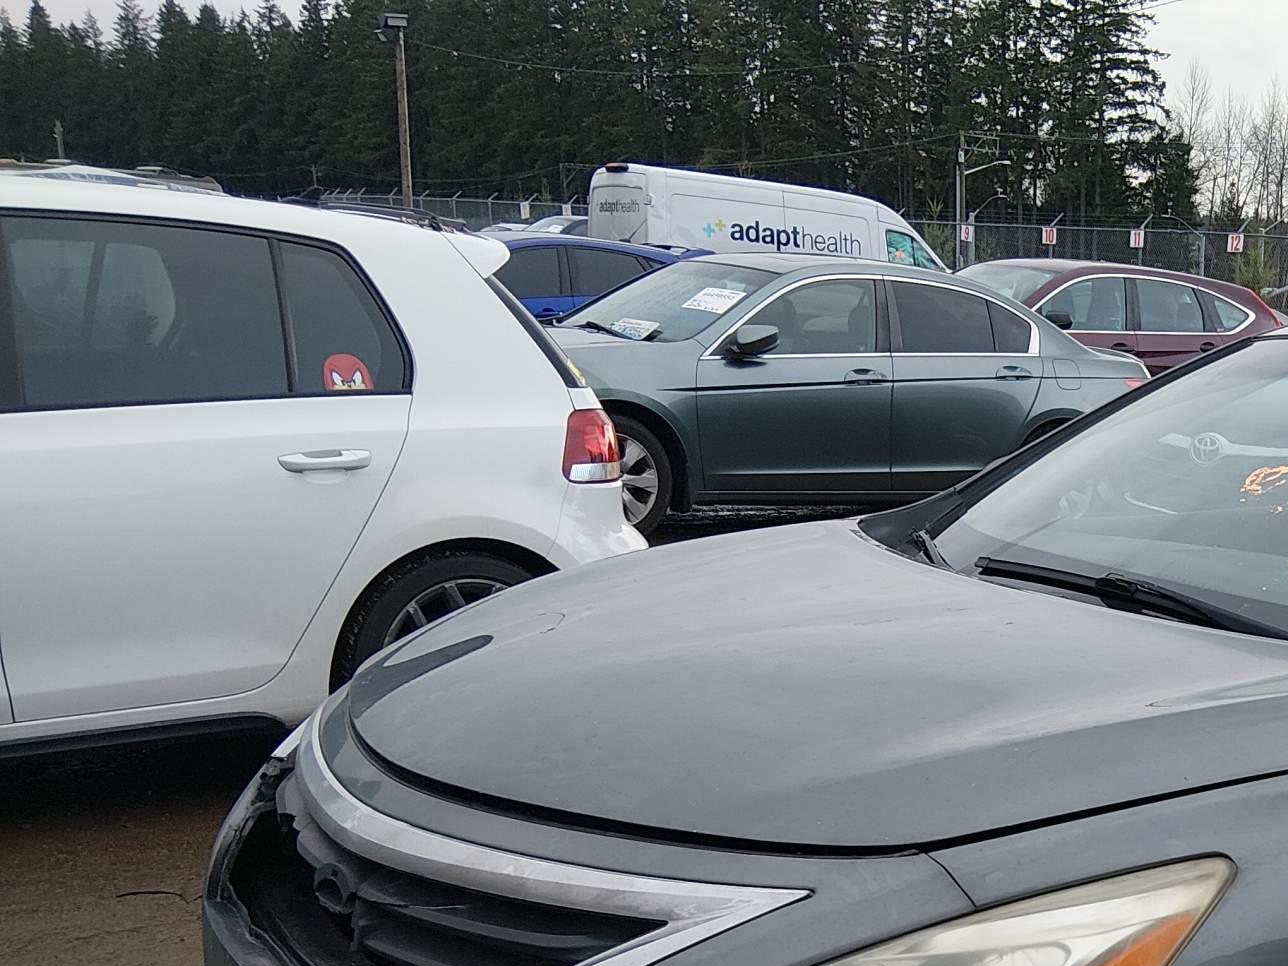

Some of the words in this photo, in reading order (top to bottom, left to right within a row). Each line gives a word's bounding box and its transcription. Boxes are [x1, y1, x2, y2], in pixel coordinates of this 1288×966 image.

[599, 200, 640, 215] adapthealth
[730, 221, 861, 255] adapthealth
[963, 227, 970, 239] 9
[1044, 229, 1054, 243] 10
[1133, 232, 1141, 246] 11
[1230, 236, 1240, 250] 12
